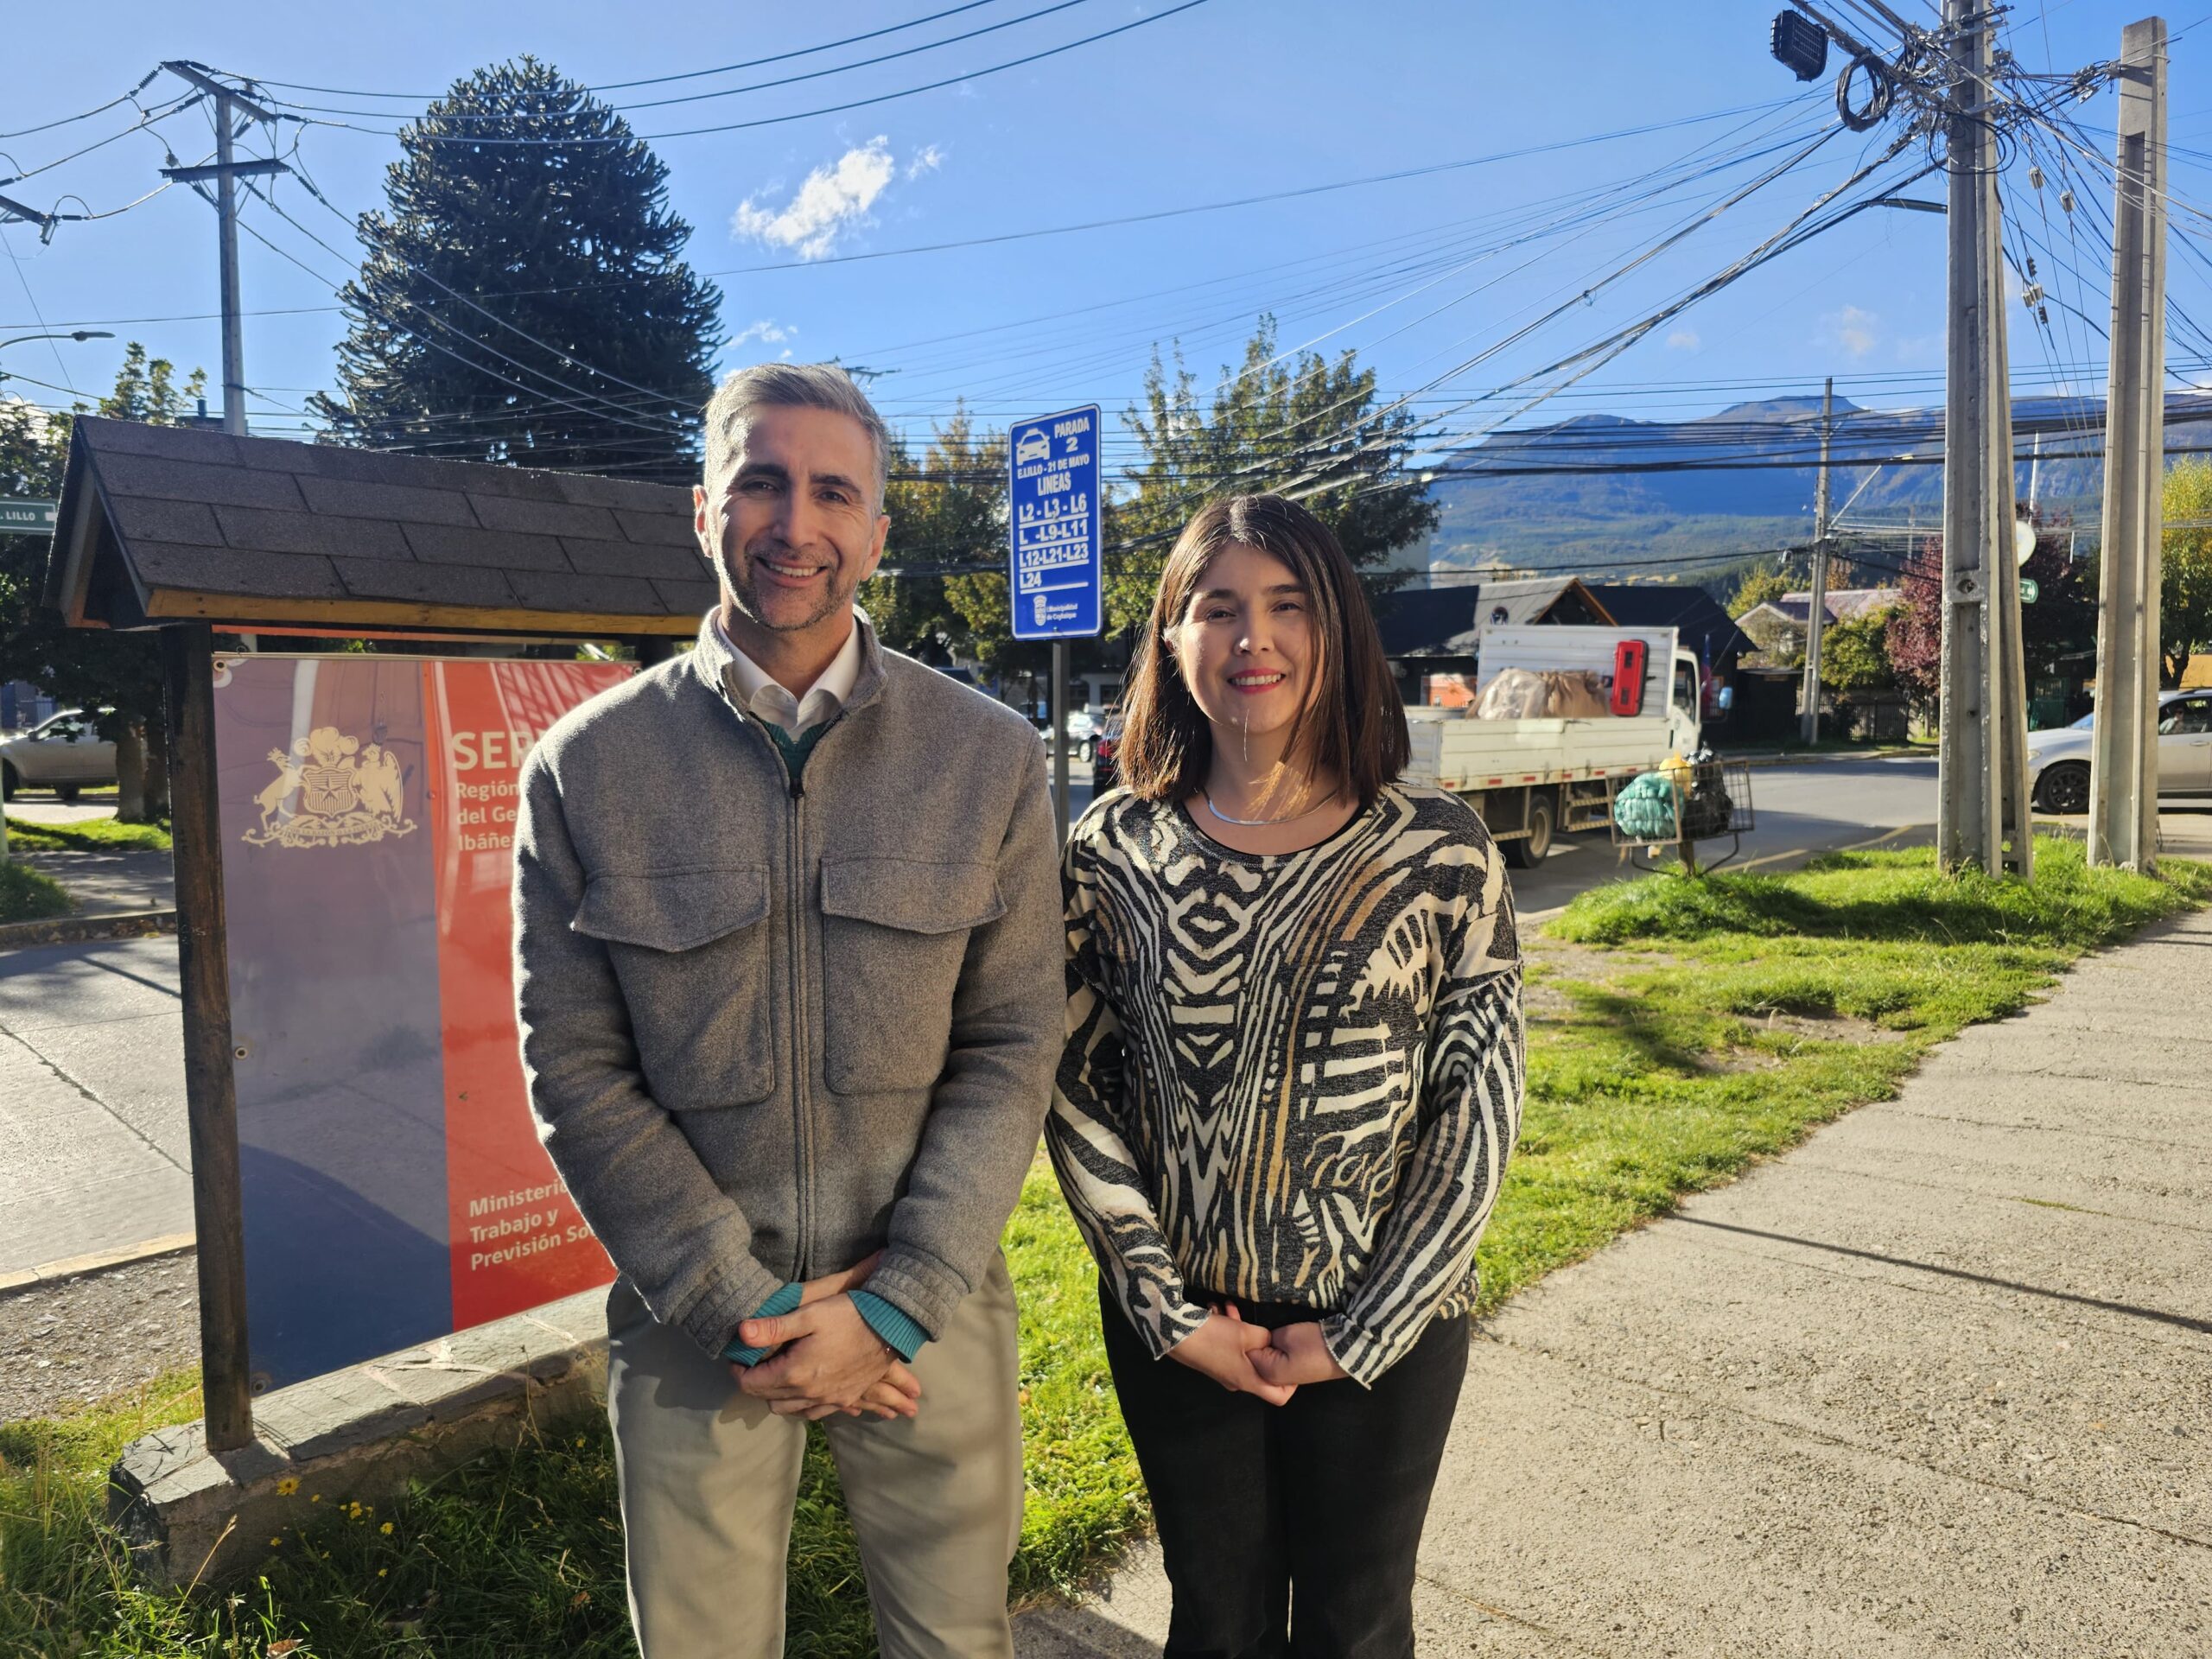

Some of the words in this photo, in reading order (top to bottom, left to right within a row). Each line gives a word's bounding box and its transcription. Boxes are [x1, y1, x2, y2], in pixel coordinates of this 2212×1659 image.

[1054, 417, 1090, 438] PARADA
[1066, 436, 1078, 453] 2
[1048, 461, 1057, 473] 21
[1058, 458, 1068, 471] DE
[1069, 454, 1090, 468] MAYO
[1038, 471, 1071, 496] LINEAS
[6, 511, 35, 521] LILLO
[1019, 503, 1034, 523] L2
[1045, 499, 1059, 519] L3
[1071, 493, 1087, 514] L6
[1020, 571, 1042, 589] L24
[456, 780, 519, 802] Región
[457, 808, 486, 825] del
[469, 1213, 542, 1244] Trabajo
[546, 1208, 559, 1226] y
[470, 1234, 562, 1271] Previsión
